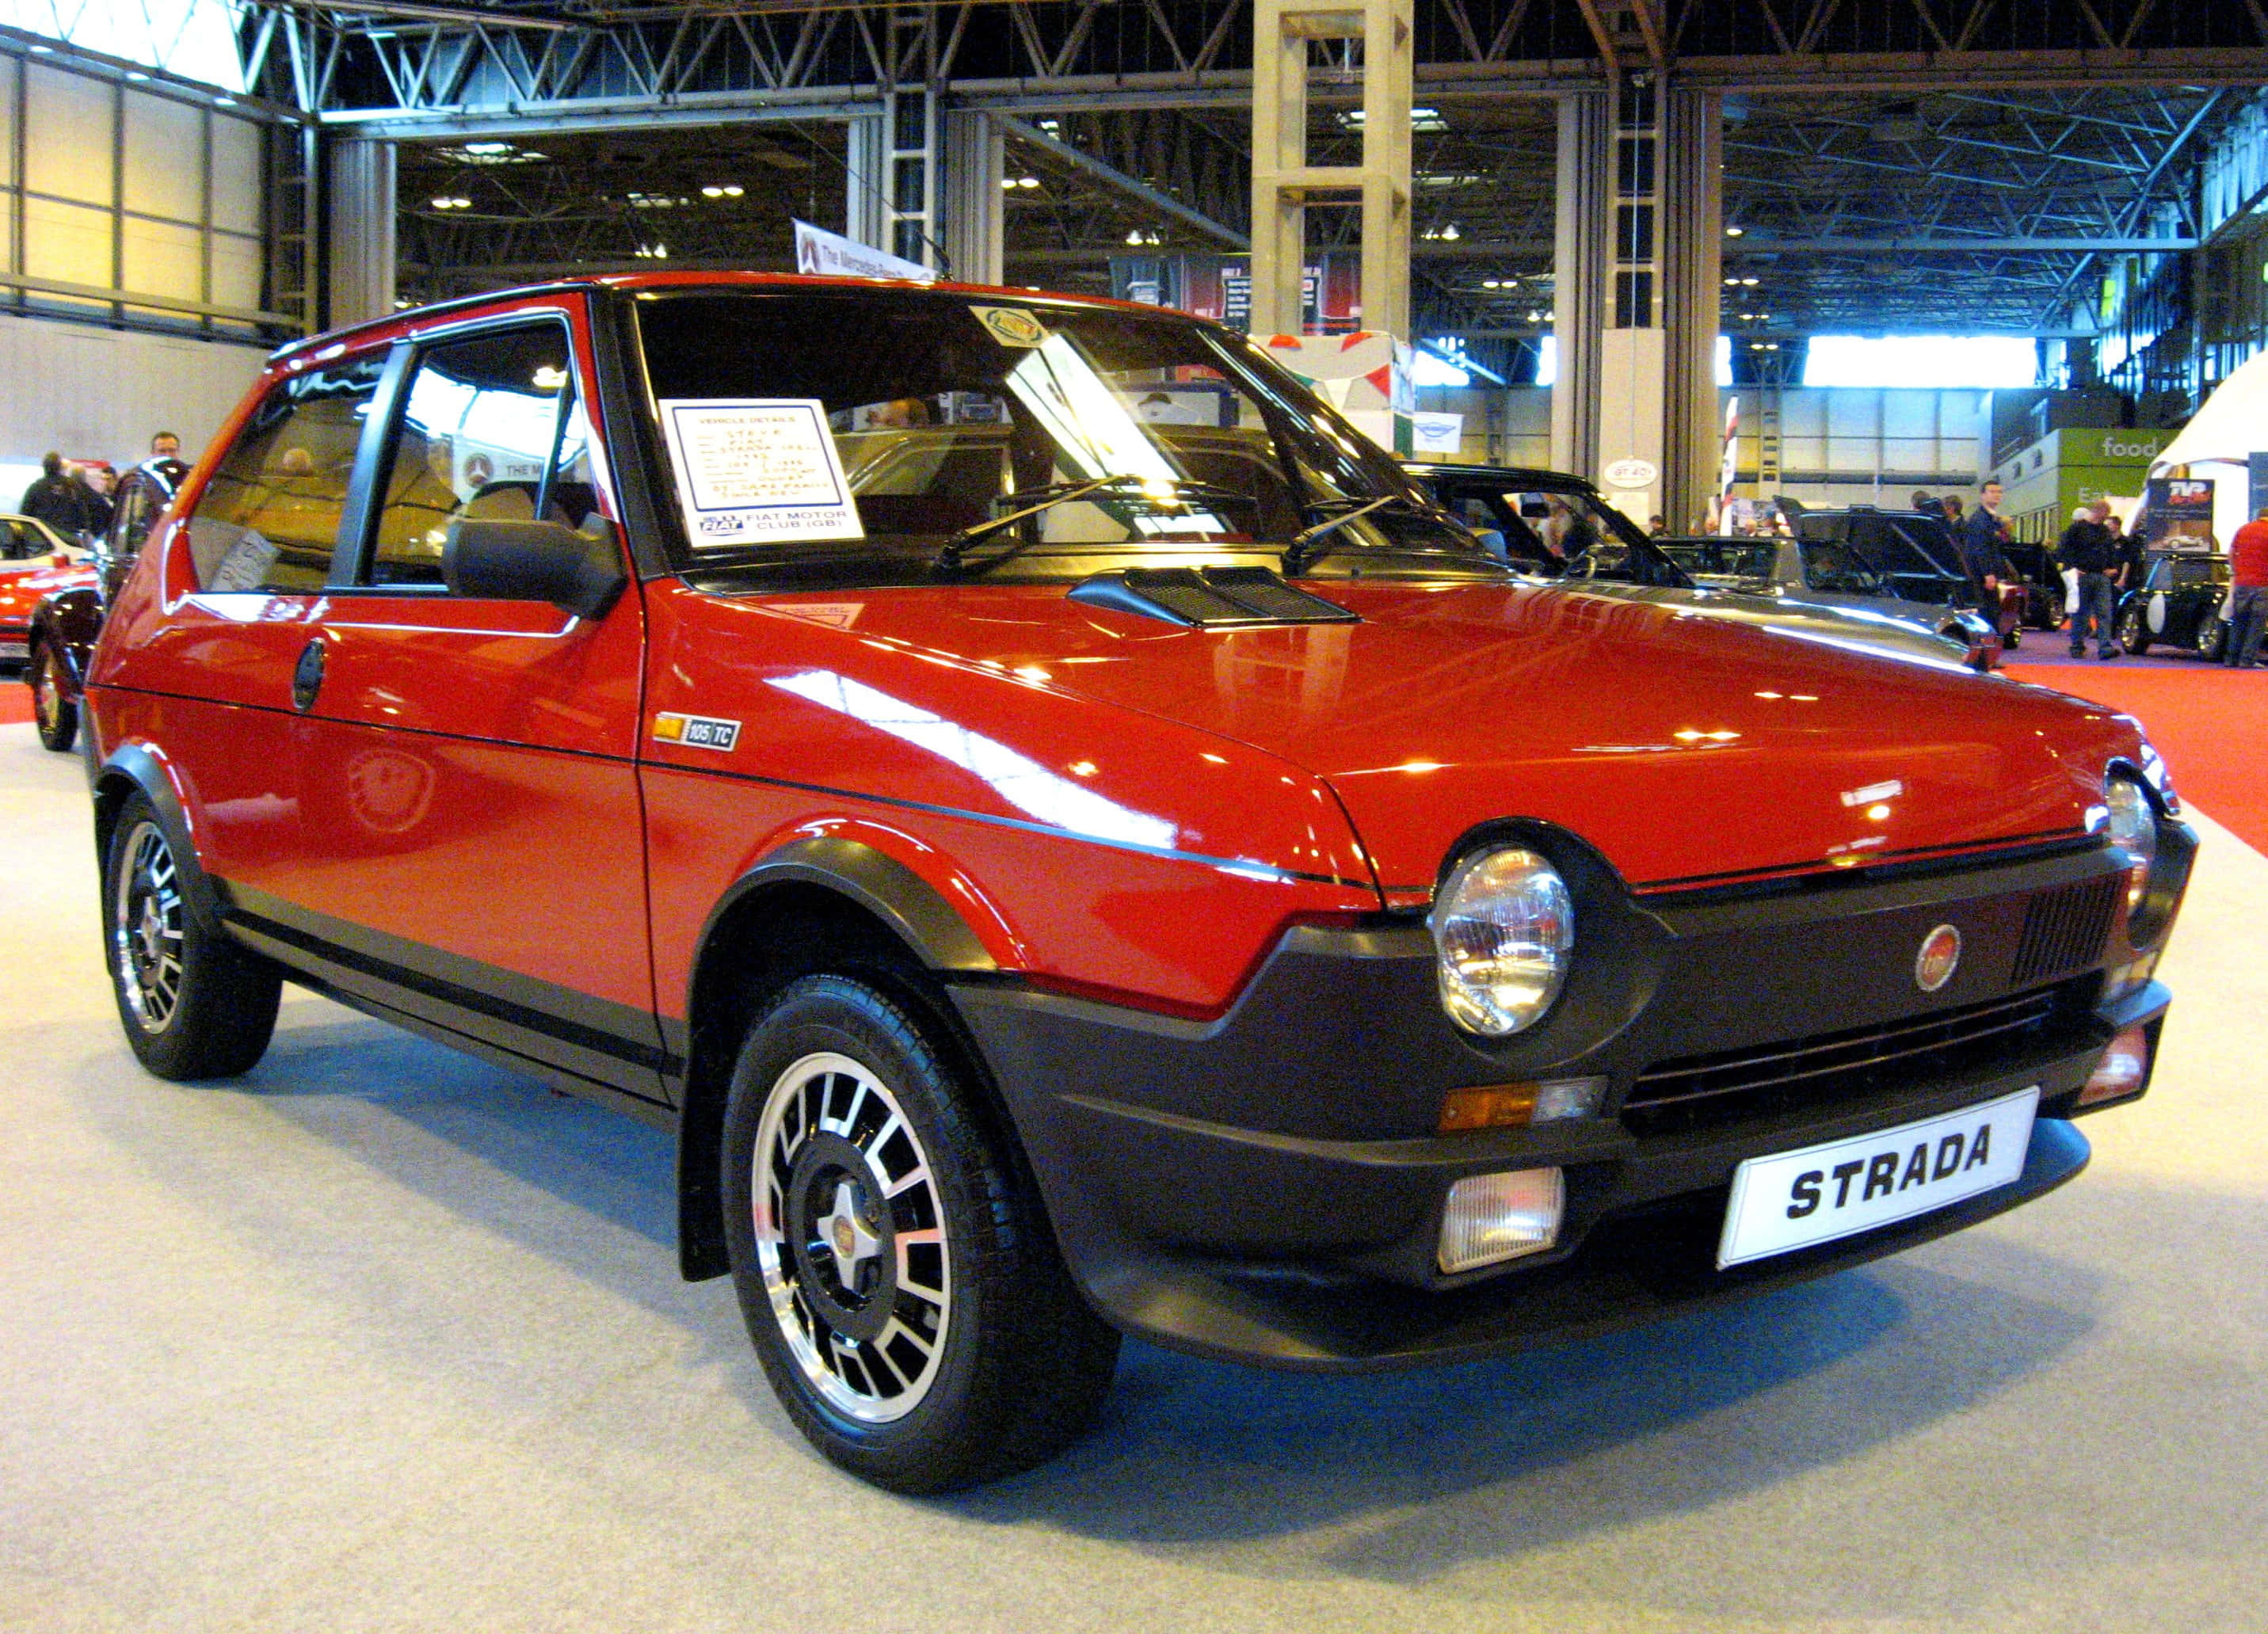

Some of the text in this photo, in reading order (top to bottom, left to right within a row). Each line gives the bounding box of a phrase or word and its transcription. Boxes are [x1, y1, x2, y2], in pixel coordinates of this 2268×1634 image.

[2102, 436, 2158, 458] food
[703, 511, 847, 531] FIAT FIAT MOTOR
[757, 520, 842, 530] CLUB (GB)
[689, 723, 732, 744] 105 TC
[1786, 1124, 1992, 1220] STRADA
